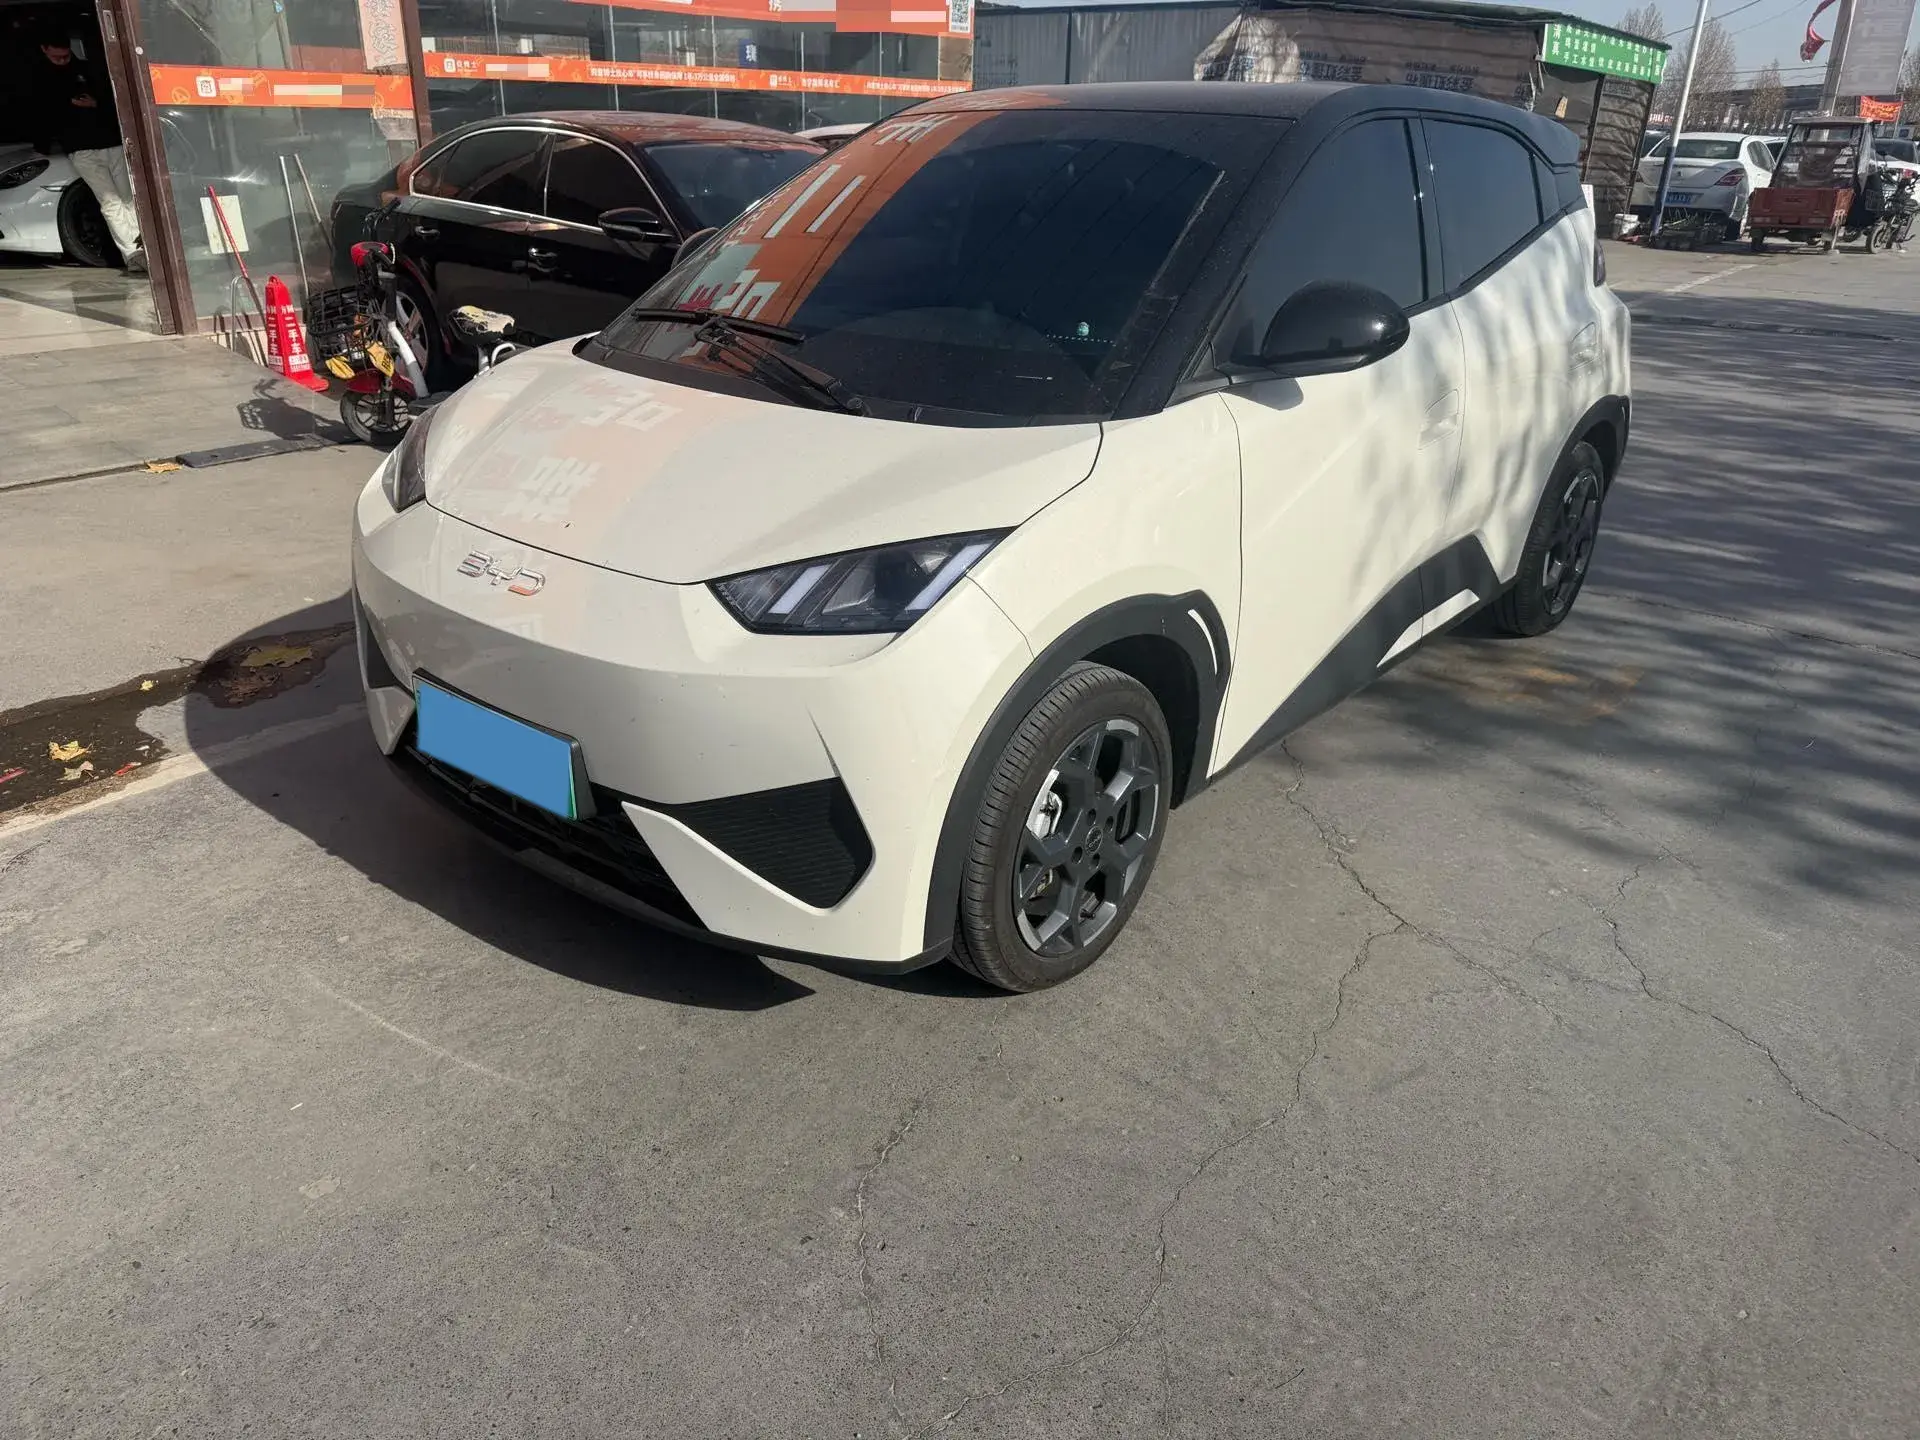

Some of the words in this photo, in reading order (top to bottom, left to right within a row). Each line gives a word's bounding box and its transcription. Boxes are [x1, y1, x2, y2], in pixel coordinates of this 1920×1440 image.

[284, 316, 303, 356] 二手车
[457, 550, 547, 597] BYD
